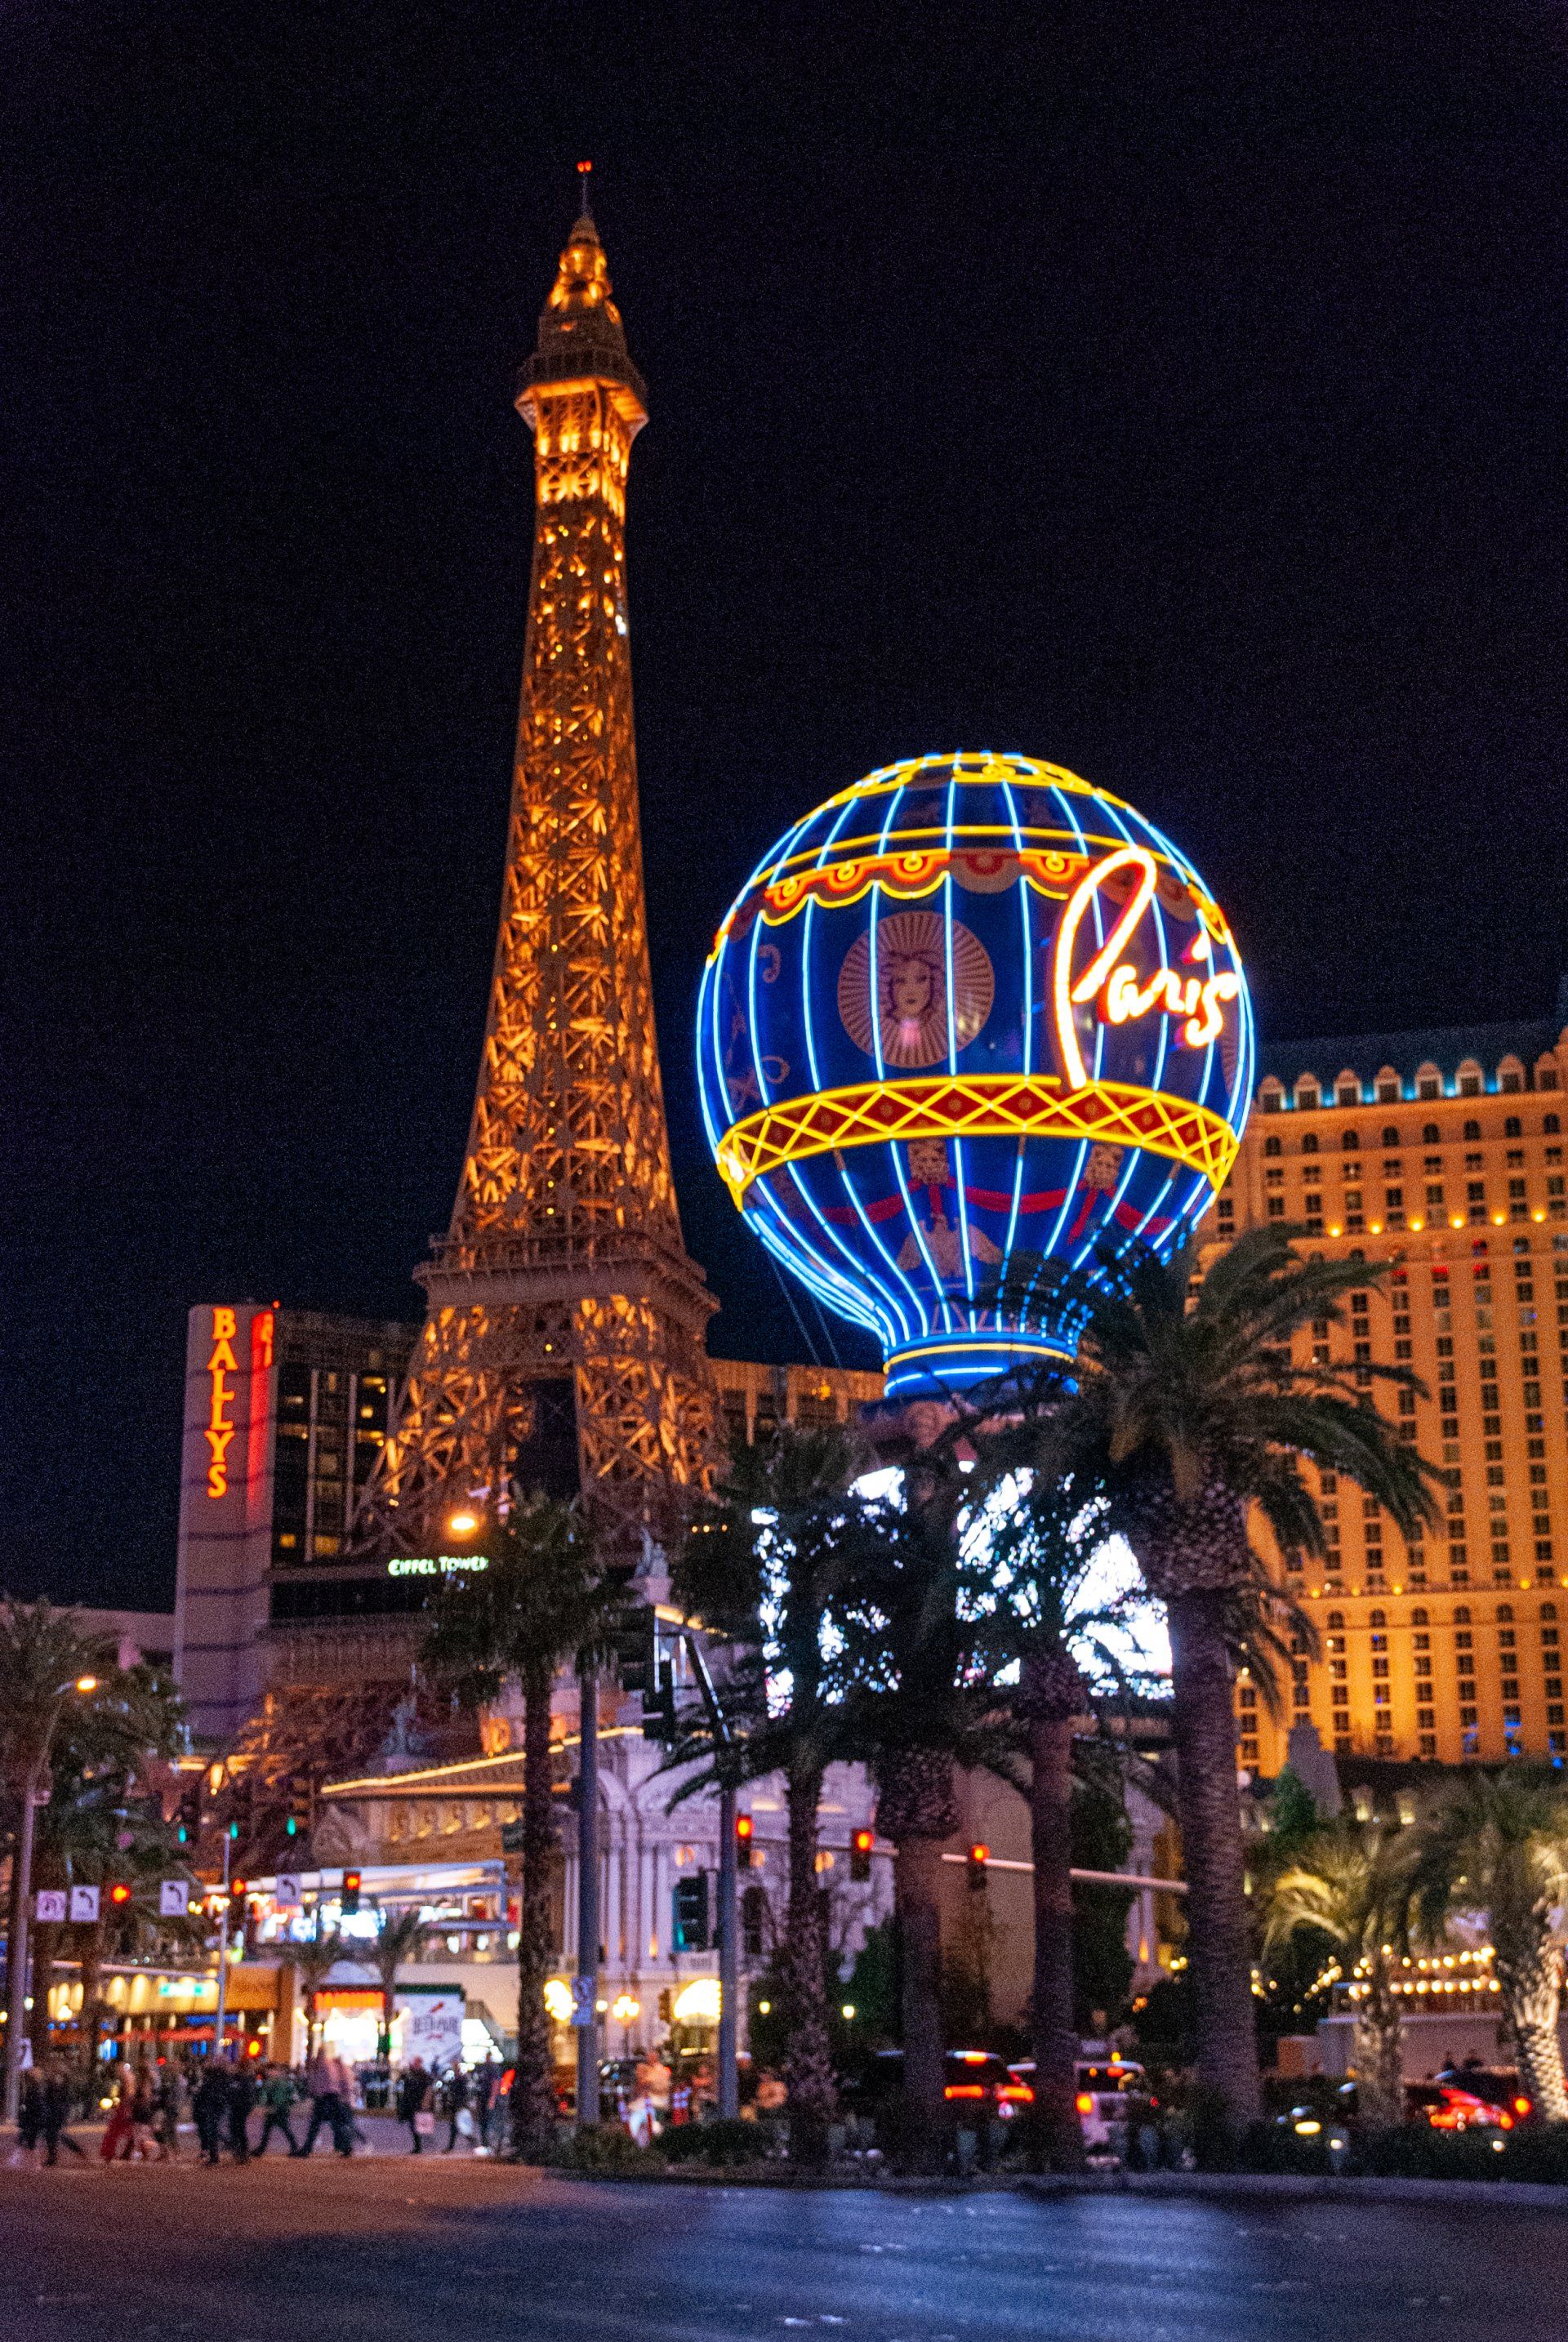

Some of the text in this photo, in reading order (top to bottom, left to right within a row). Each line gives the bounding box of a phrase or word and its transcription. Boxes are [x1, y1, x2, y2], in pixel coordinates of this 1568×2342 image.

[1054, 848, 1241, 1089] Paris
[204, 1307, 238, 1498] BALLYS
[388, 1558, 437, 1576] EIFFEL
